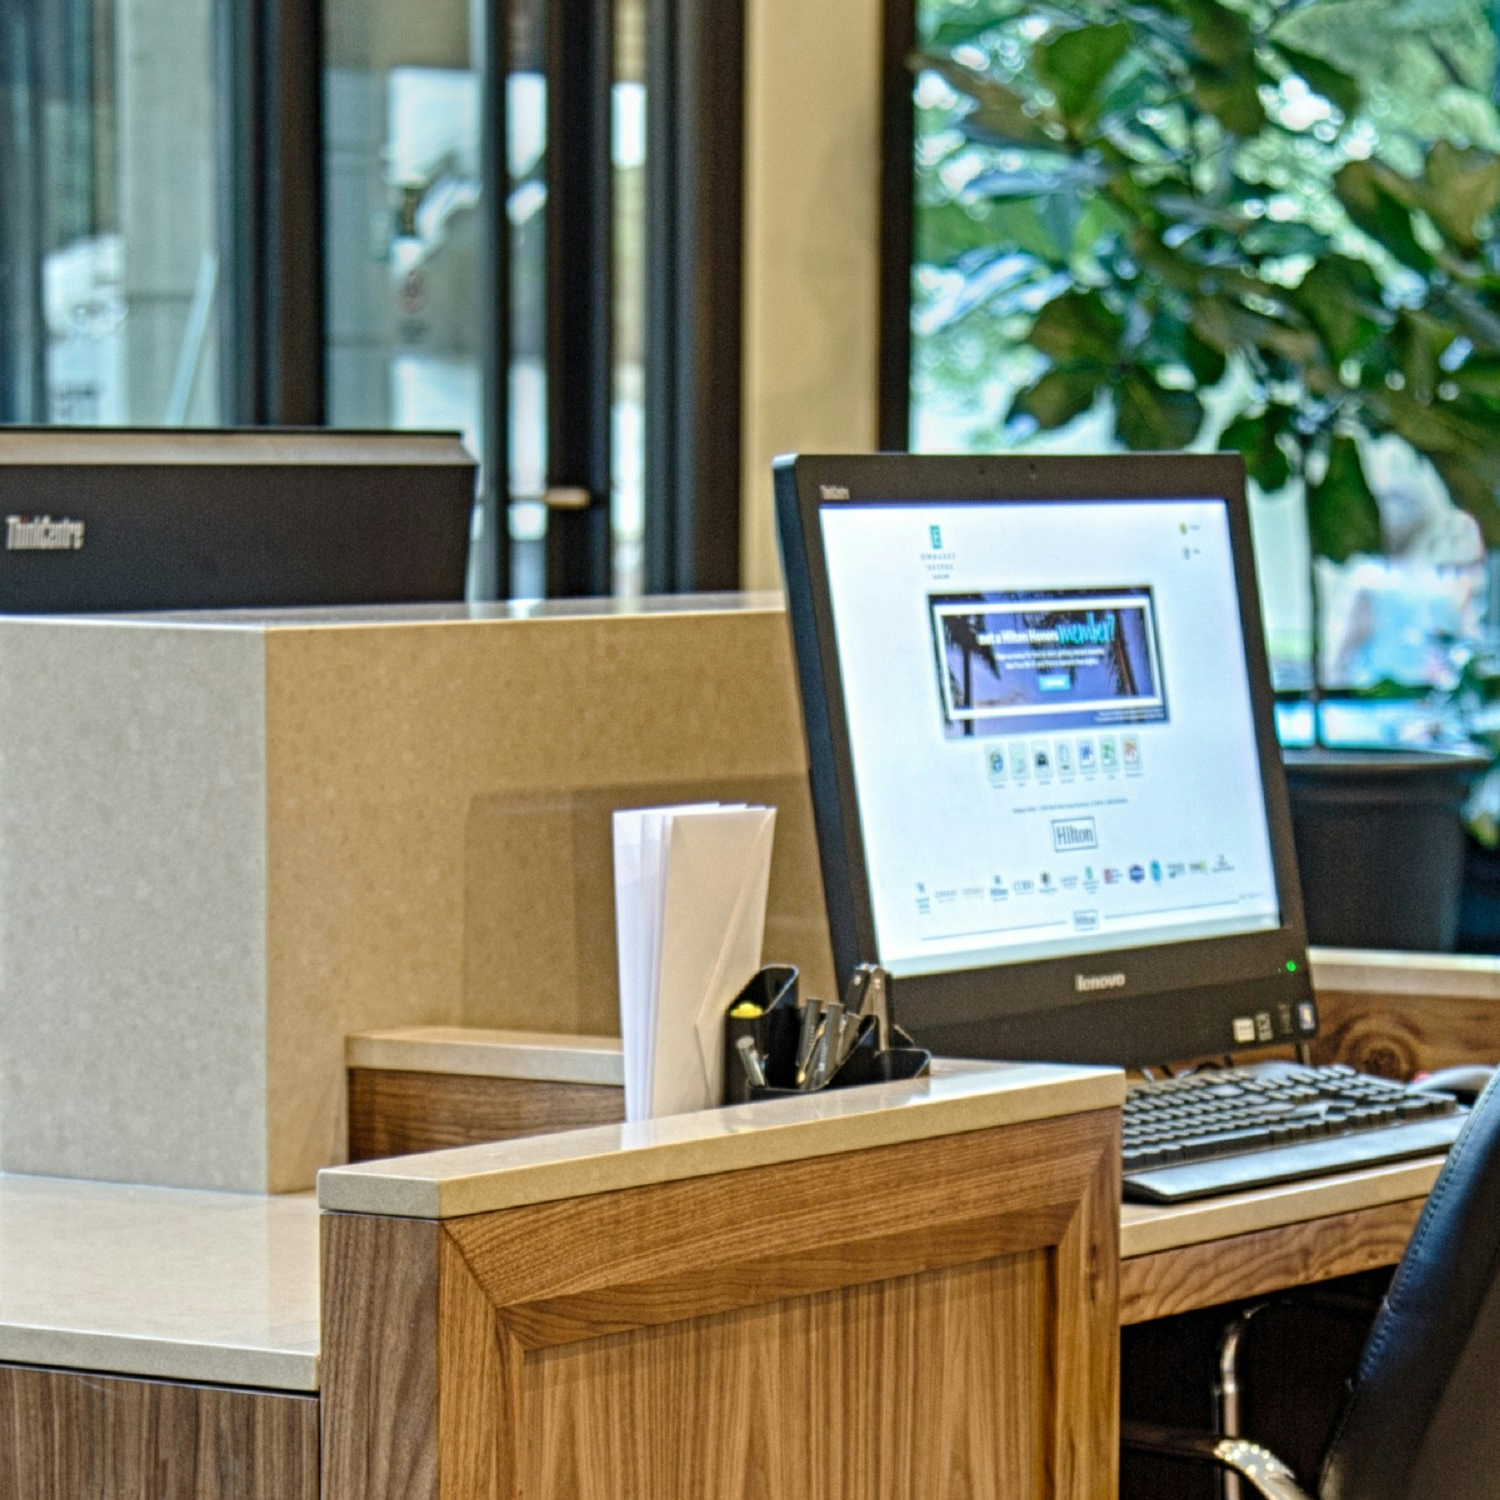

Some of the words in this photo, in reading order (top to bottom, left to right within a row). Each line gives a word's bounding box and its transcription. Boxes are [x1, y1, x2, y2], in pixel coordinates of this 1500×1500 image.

[5, 515, 85, 550] ThinkCentre
[1056, 824, 1094, 845] Hilton
[1075, 973, 1126, 991] lenovo
